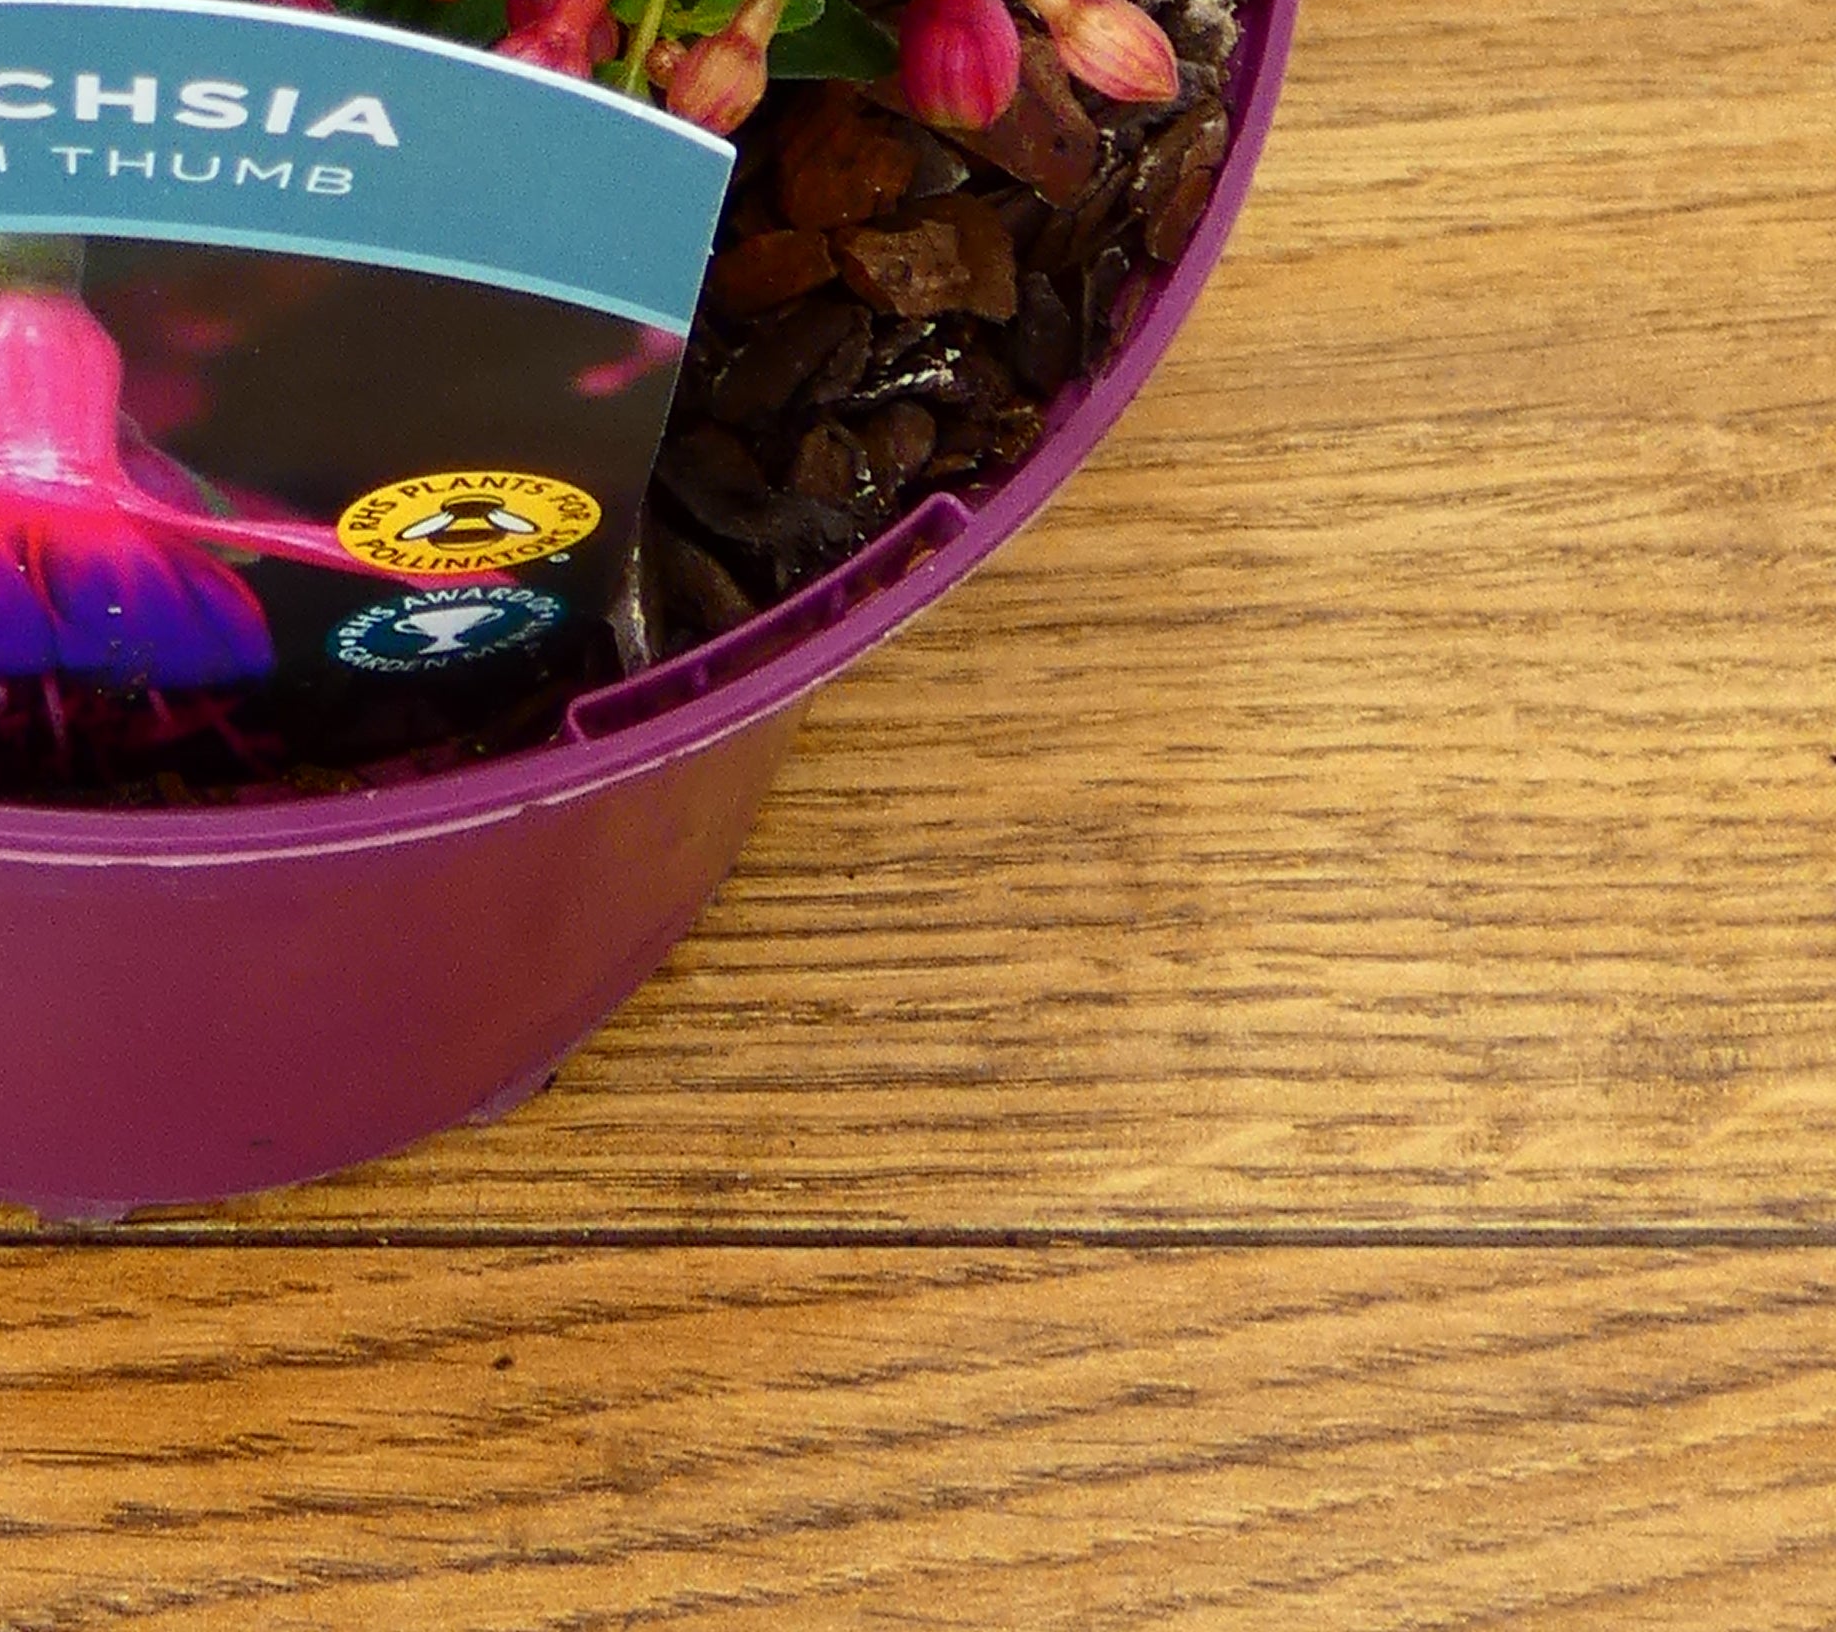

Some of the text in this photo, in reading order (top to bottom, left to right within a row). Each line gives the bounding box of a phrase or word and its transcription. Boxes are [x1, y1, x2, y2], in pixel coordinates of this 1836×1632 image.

[51, 146, 354, 196] THUMB
[349, 475, 592, 531] RHS PLANTS FOR
[356, 528, 579, 570] POLLINATORS
[338, 605, 397, 638] RHS
[402, 586, 535, 611] AWARD
